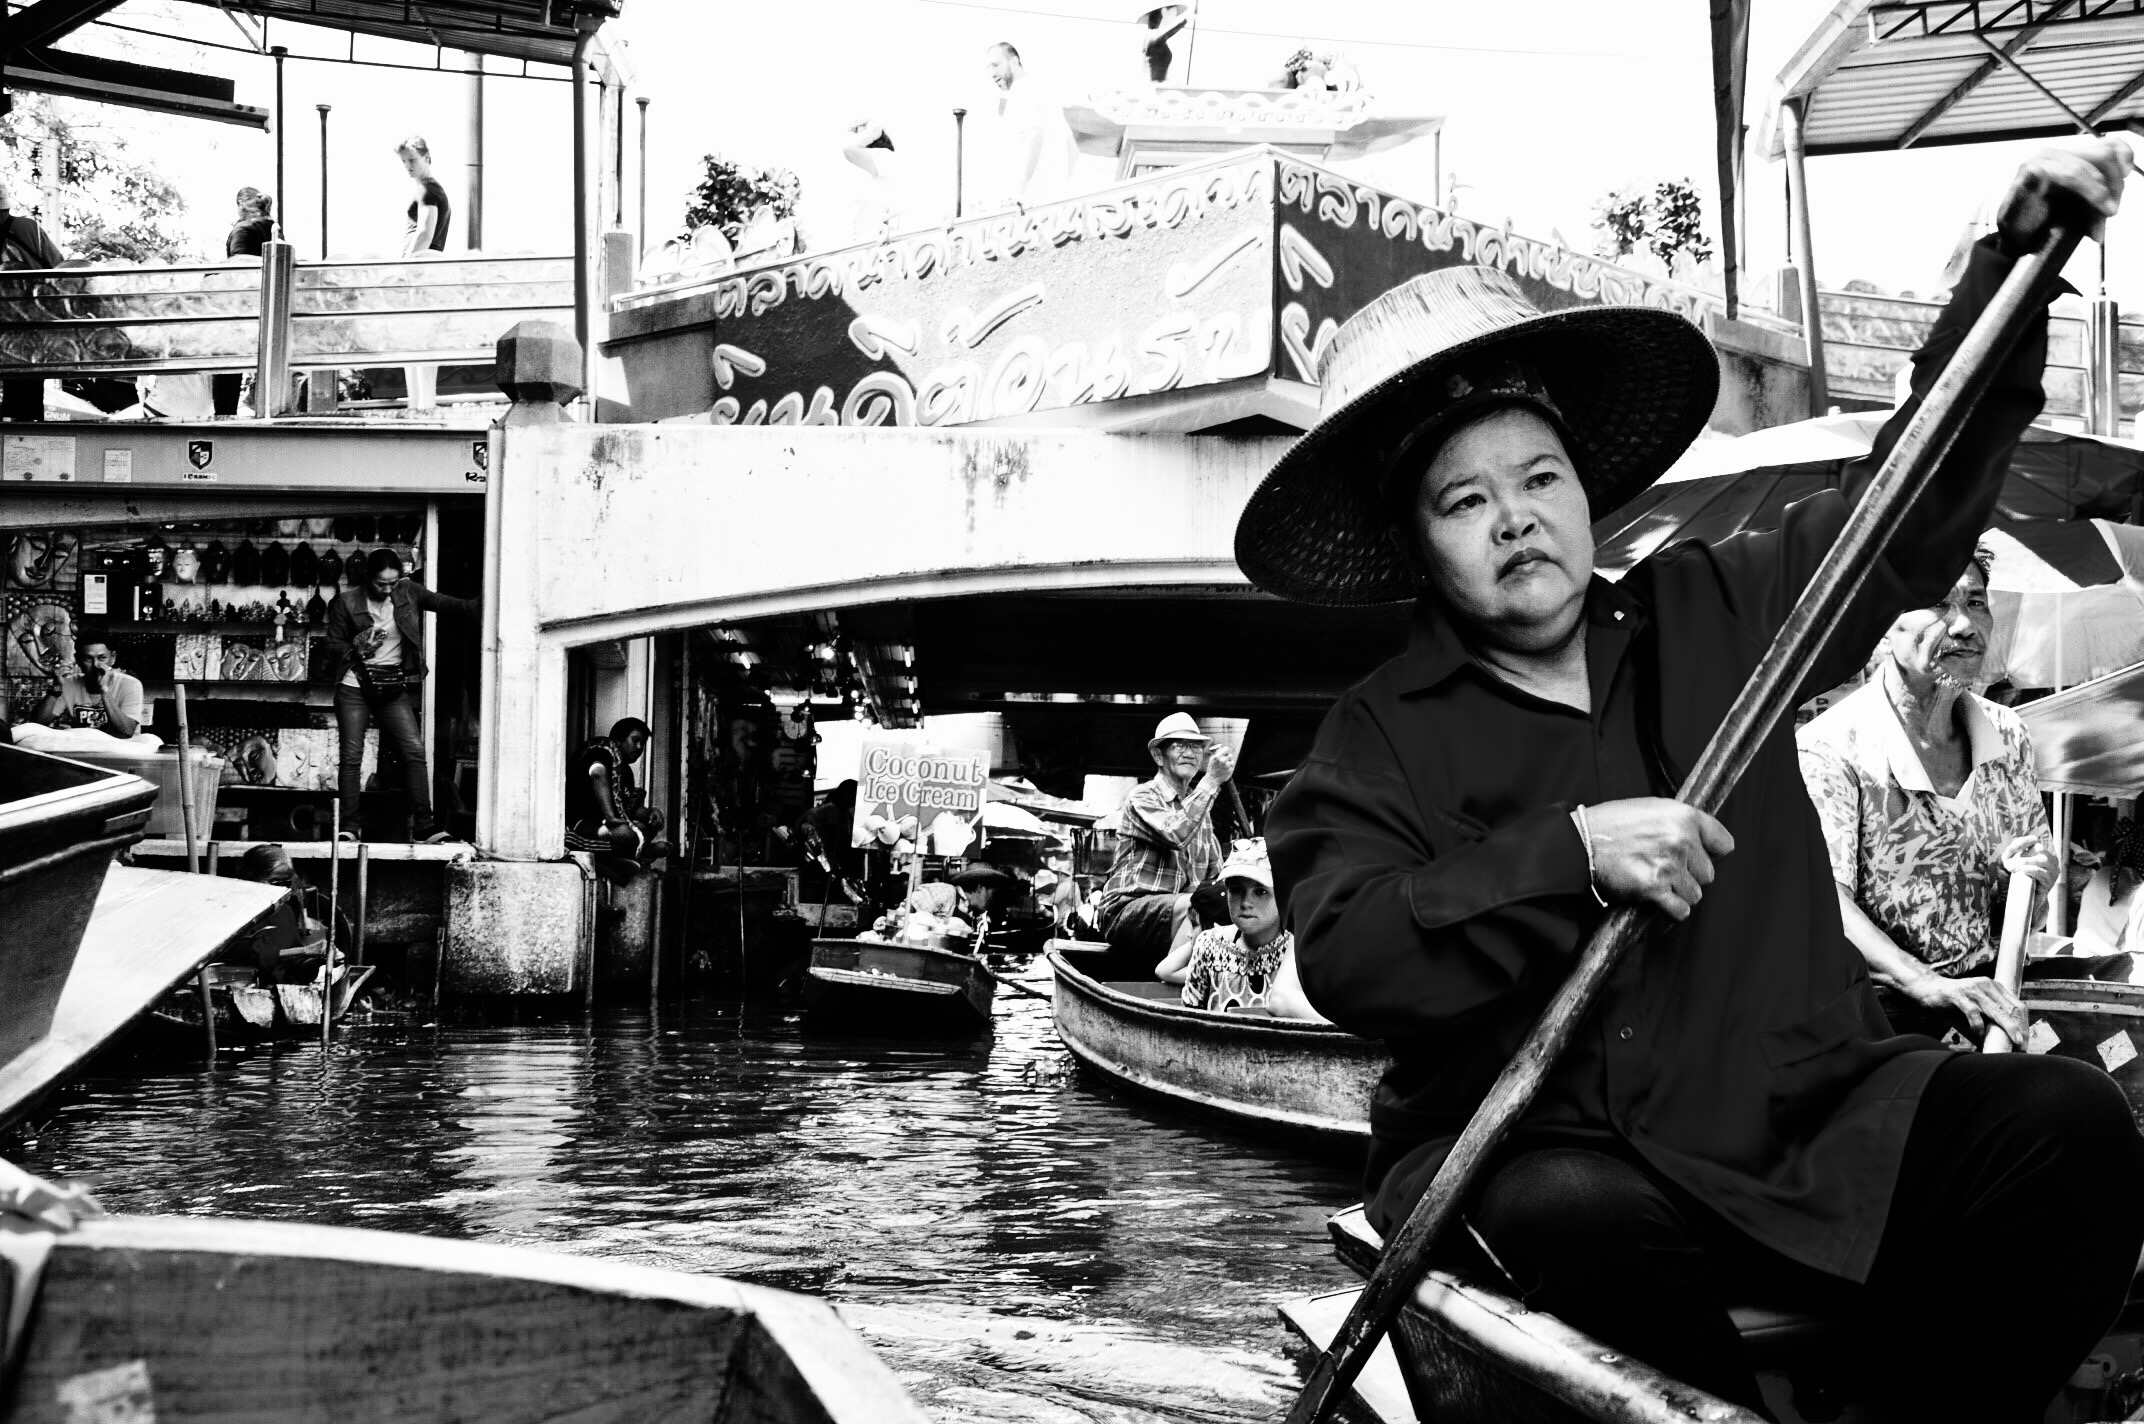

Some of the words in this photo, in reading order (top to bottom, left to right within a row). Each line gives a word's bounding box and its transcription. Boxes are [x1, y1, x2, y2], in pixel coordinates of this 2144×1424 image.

[866, 748, 982, 784] Coconut
[867, 776, 898, 801] Ice
[903, 780, 977, 809] Cream
